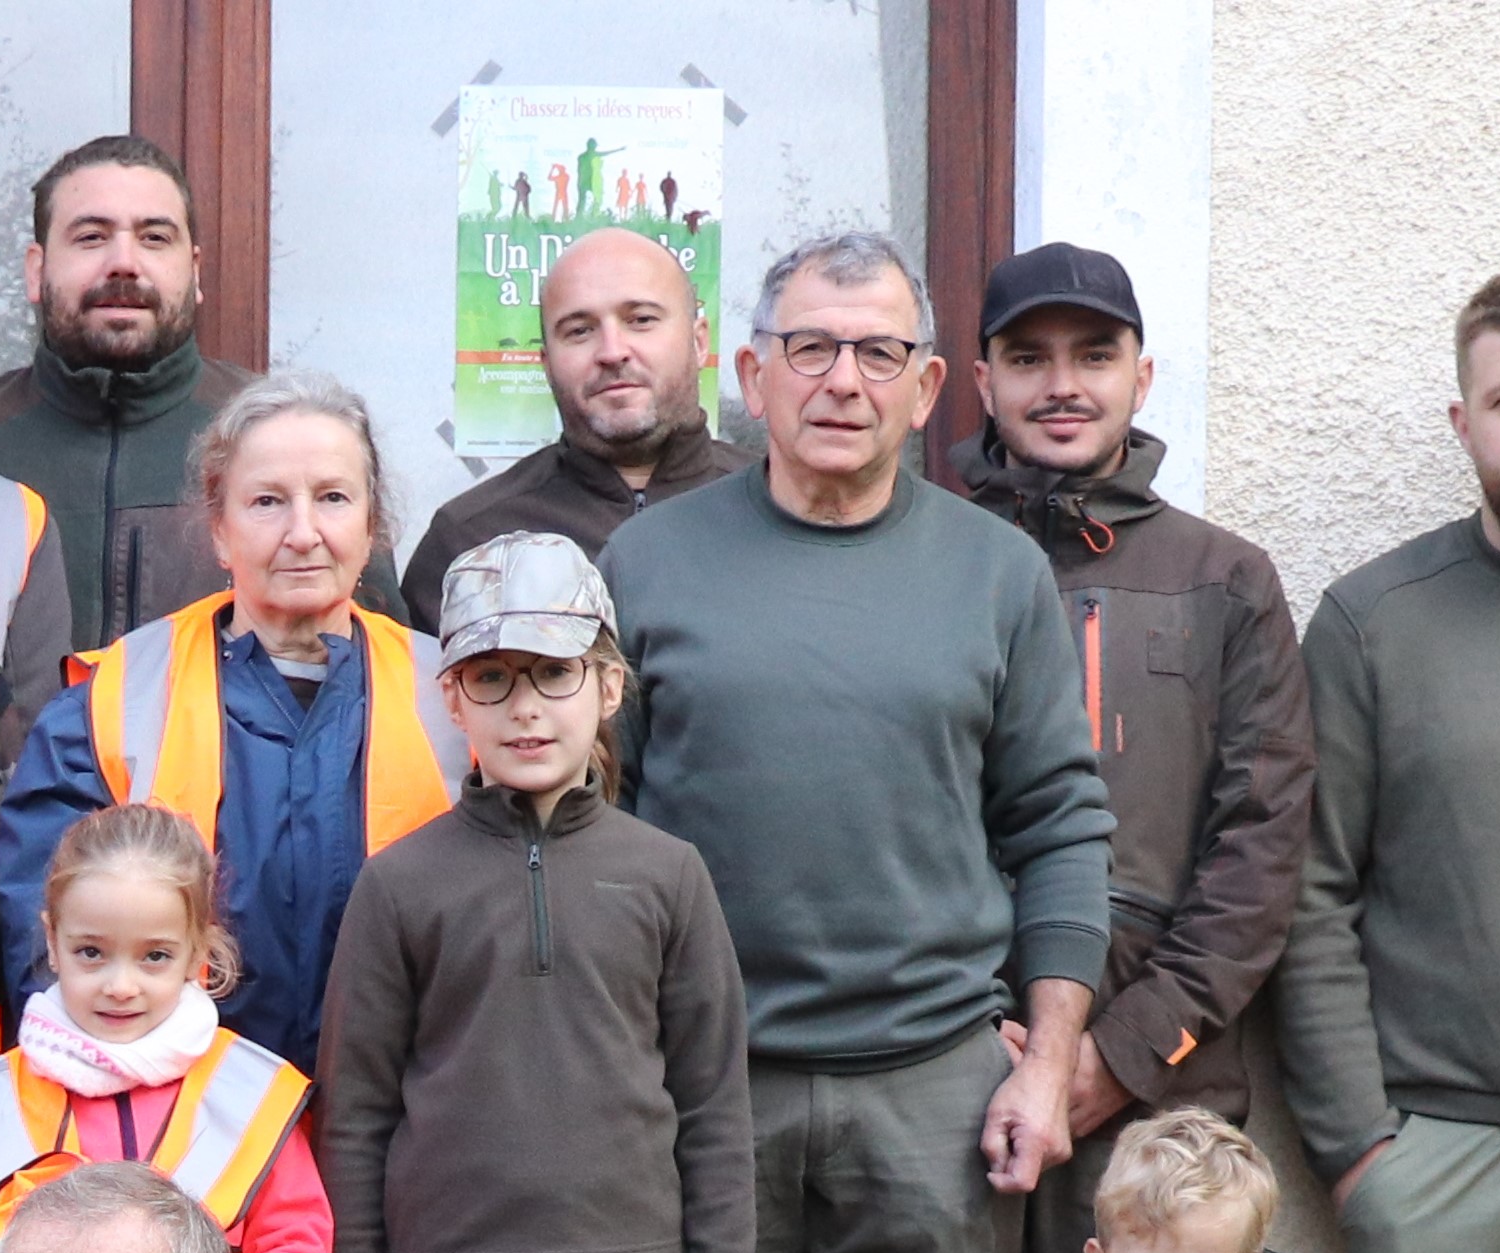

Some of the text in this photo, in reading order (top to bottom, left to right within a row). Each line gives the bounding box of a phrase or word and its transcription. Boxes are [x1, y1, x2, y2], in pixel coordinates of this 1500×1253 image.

[510, 97, 568, 121] Chassez
[573, 97, 592, 117] les
[597, 97, 632, 118] idées
[637, 103, 683, 123] reçues
[484, 233, 529, 277] Un
[500, 271, 521, 305] à
